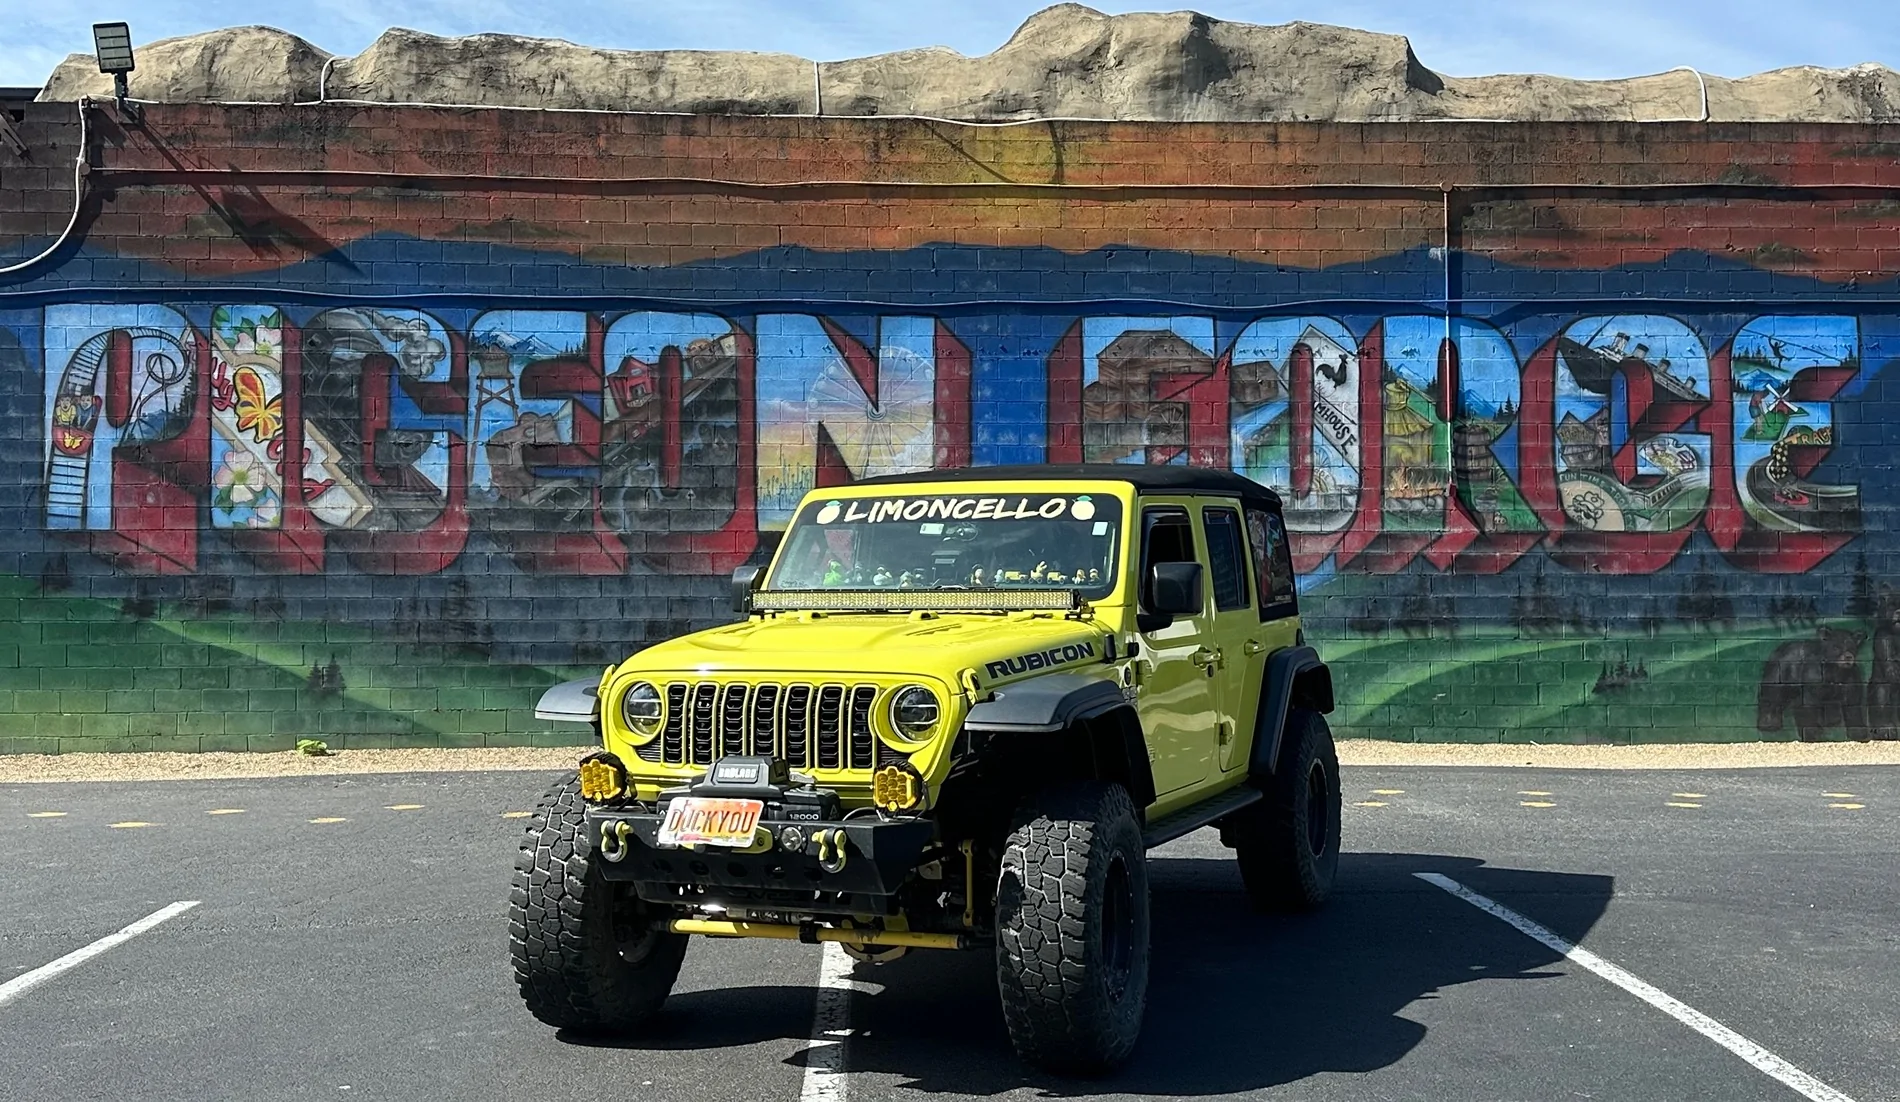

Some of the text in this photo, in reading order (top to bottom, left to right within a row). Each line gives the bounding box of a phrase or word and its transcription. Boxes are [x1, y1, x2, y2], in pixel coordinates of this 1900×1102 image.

[43, 303, 970, 575] PIGEON
[1047, 314, 1861, 573] FORGE
[1314, 401, 1357, 456] MHOUSE
[1559, 473, 1577, 482] FUN
[1581, 474, 1605, 488] TIME
[843, 497, 1067, 523] LIMONCELLO
[984, 642, 1095, 679] RUBICON
[667, 808, 755, 834] DUCKYOU
